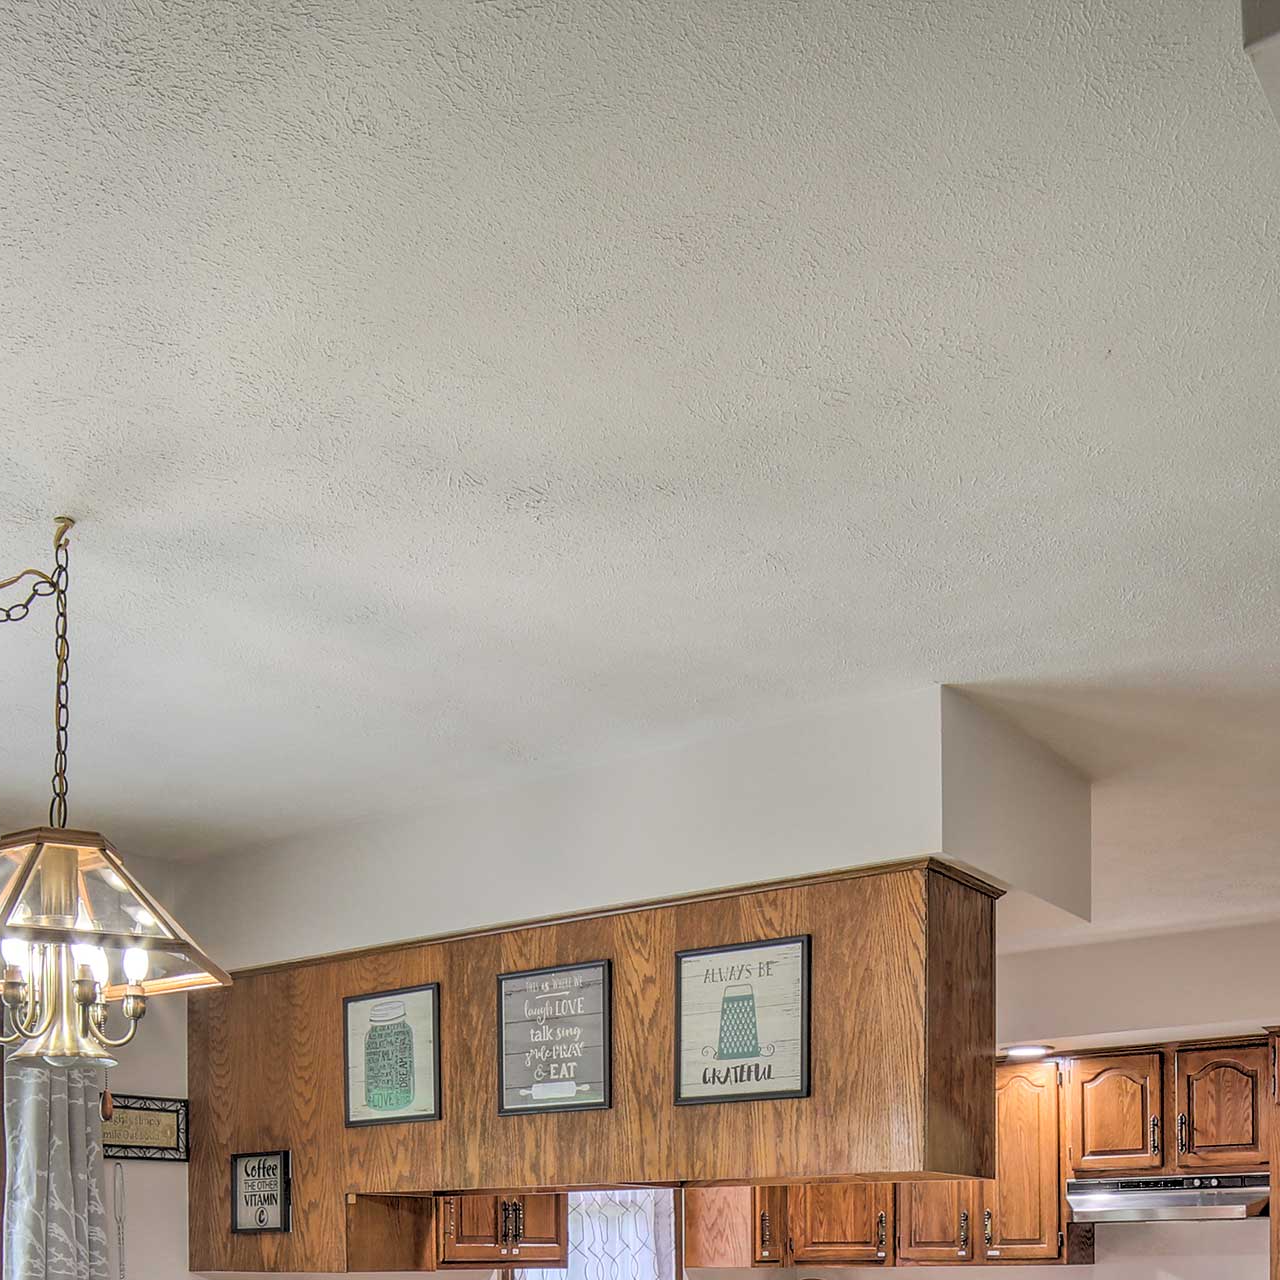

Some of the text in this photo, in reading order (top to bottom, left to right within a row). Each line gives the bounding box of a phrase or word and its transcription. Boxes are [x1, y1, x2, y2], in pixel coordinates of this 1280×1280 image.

[704, 961, 774, 983] ALWAYS BE
[524, 997, 585, 1025] laugh LOVE
[530, 1025, 581, 1042] talk sing
[552, 1041, 585, 1059] PRAY
[534, 1062, 577, 1081] & EAT
[702, 1063, 775, 1085] GRATEFUL
[244, 1159, 277, 1178] Coffee
[244, 1181, 278, 1191] THE OTHER
[244, 1193, 278, 1207] VITAMIN
[258, 1210, 266, 1224] C
